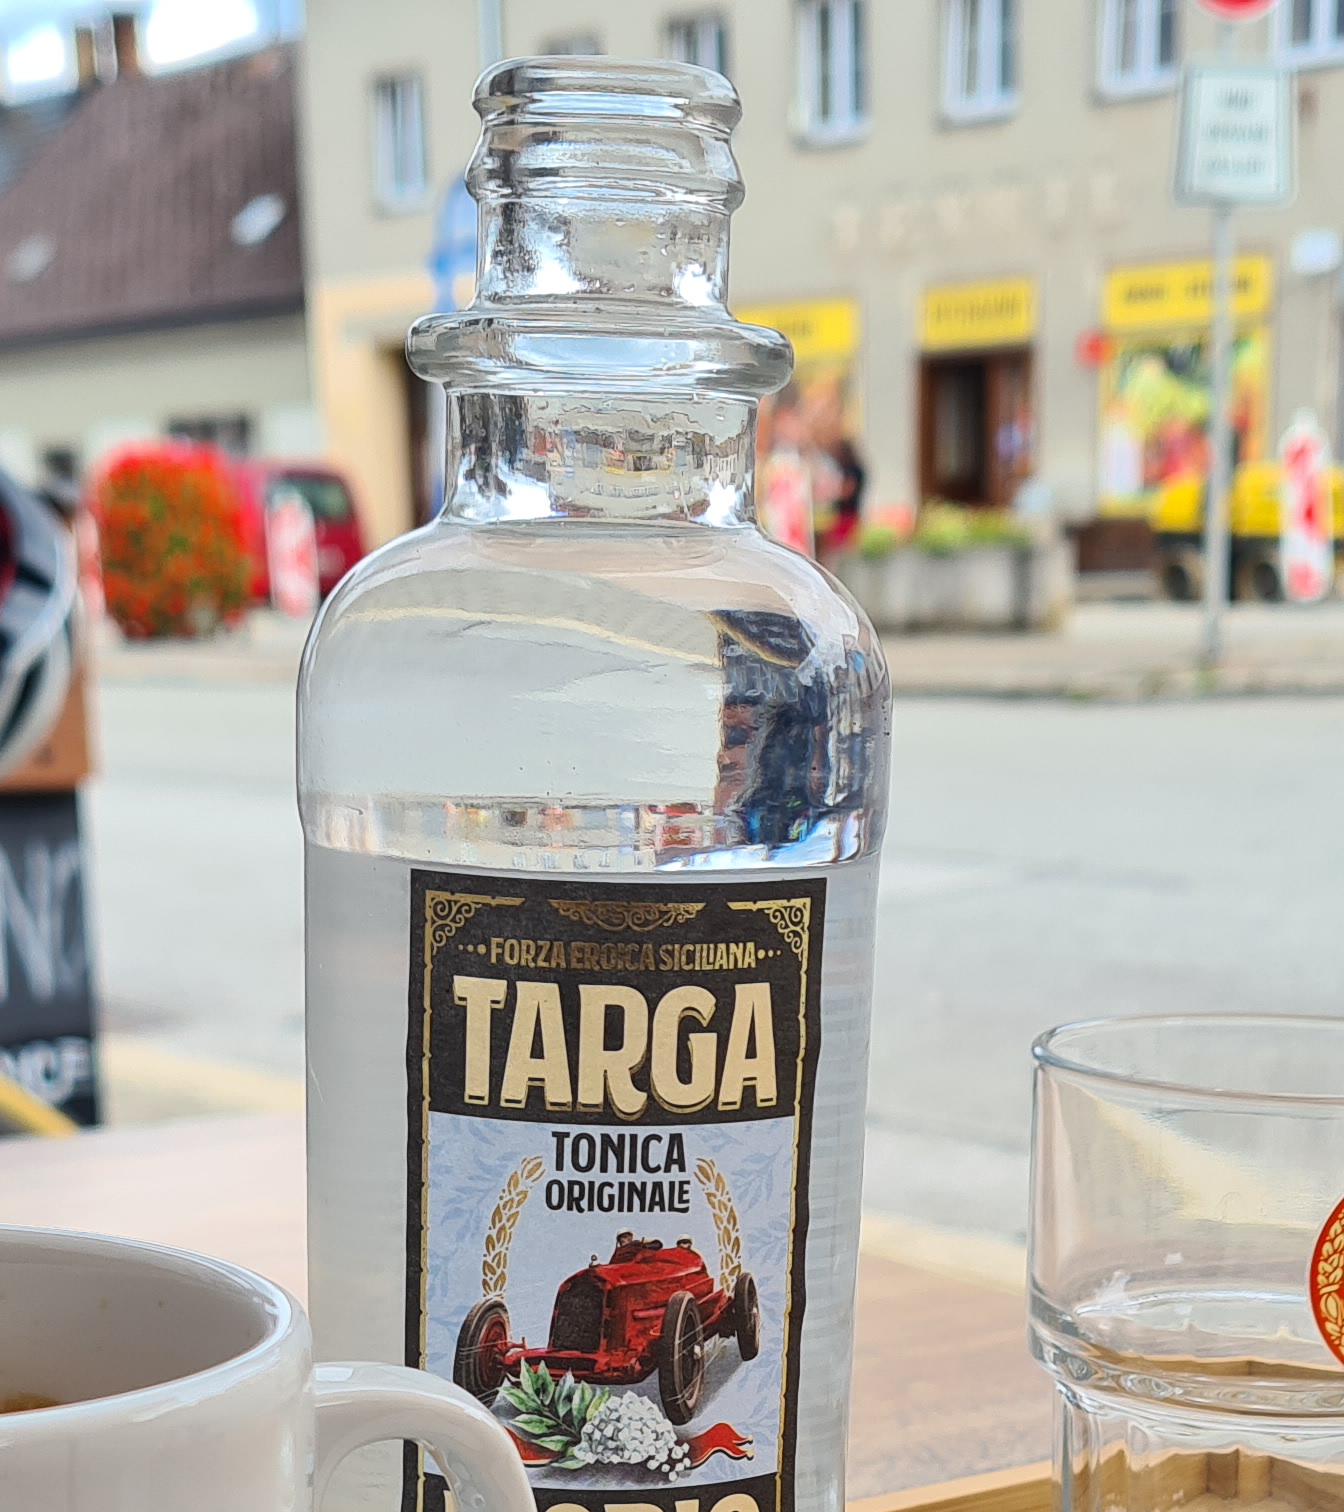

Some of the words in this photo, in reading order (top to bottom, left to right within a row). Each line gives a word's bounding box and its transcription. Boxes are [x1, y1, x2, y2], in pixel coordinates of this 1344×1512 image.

[490, 937, 567, 969] FORZA
[570, 941, 655, 971] EROICA
[659, 941, 757, 971] SICILIANA
[454, 976, 777, 1121] TARGA
[552, 1131, 687, 1174] TONICA
[545, 1180, 691, 1214] ORIGINALE
